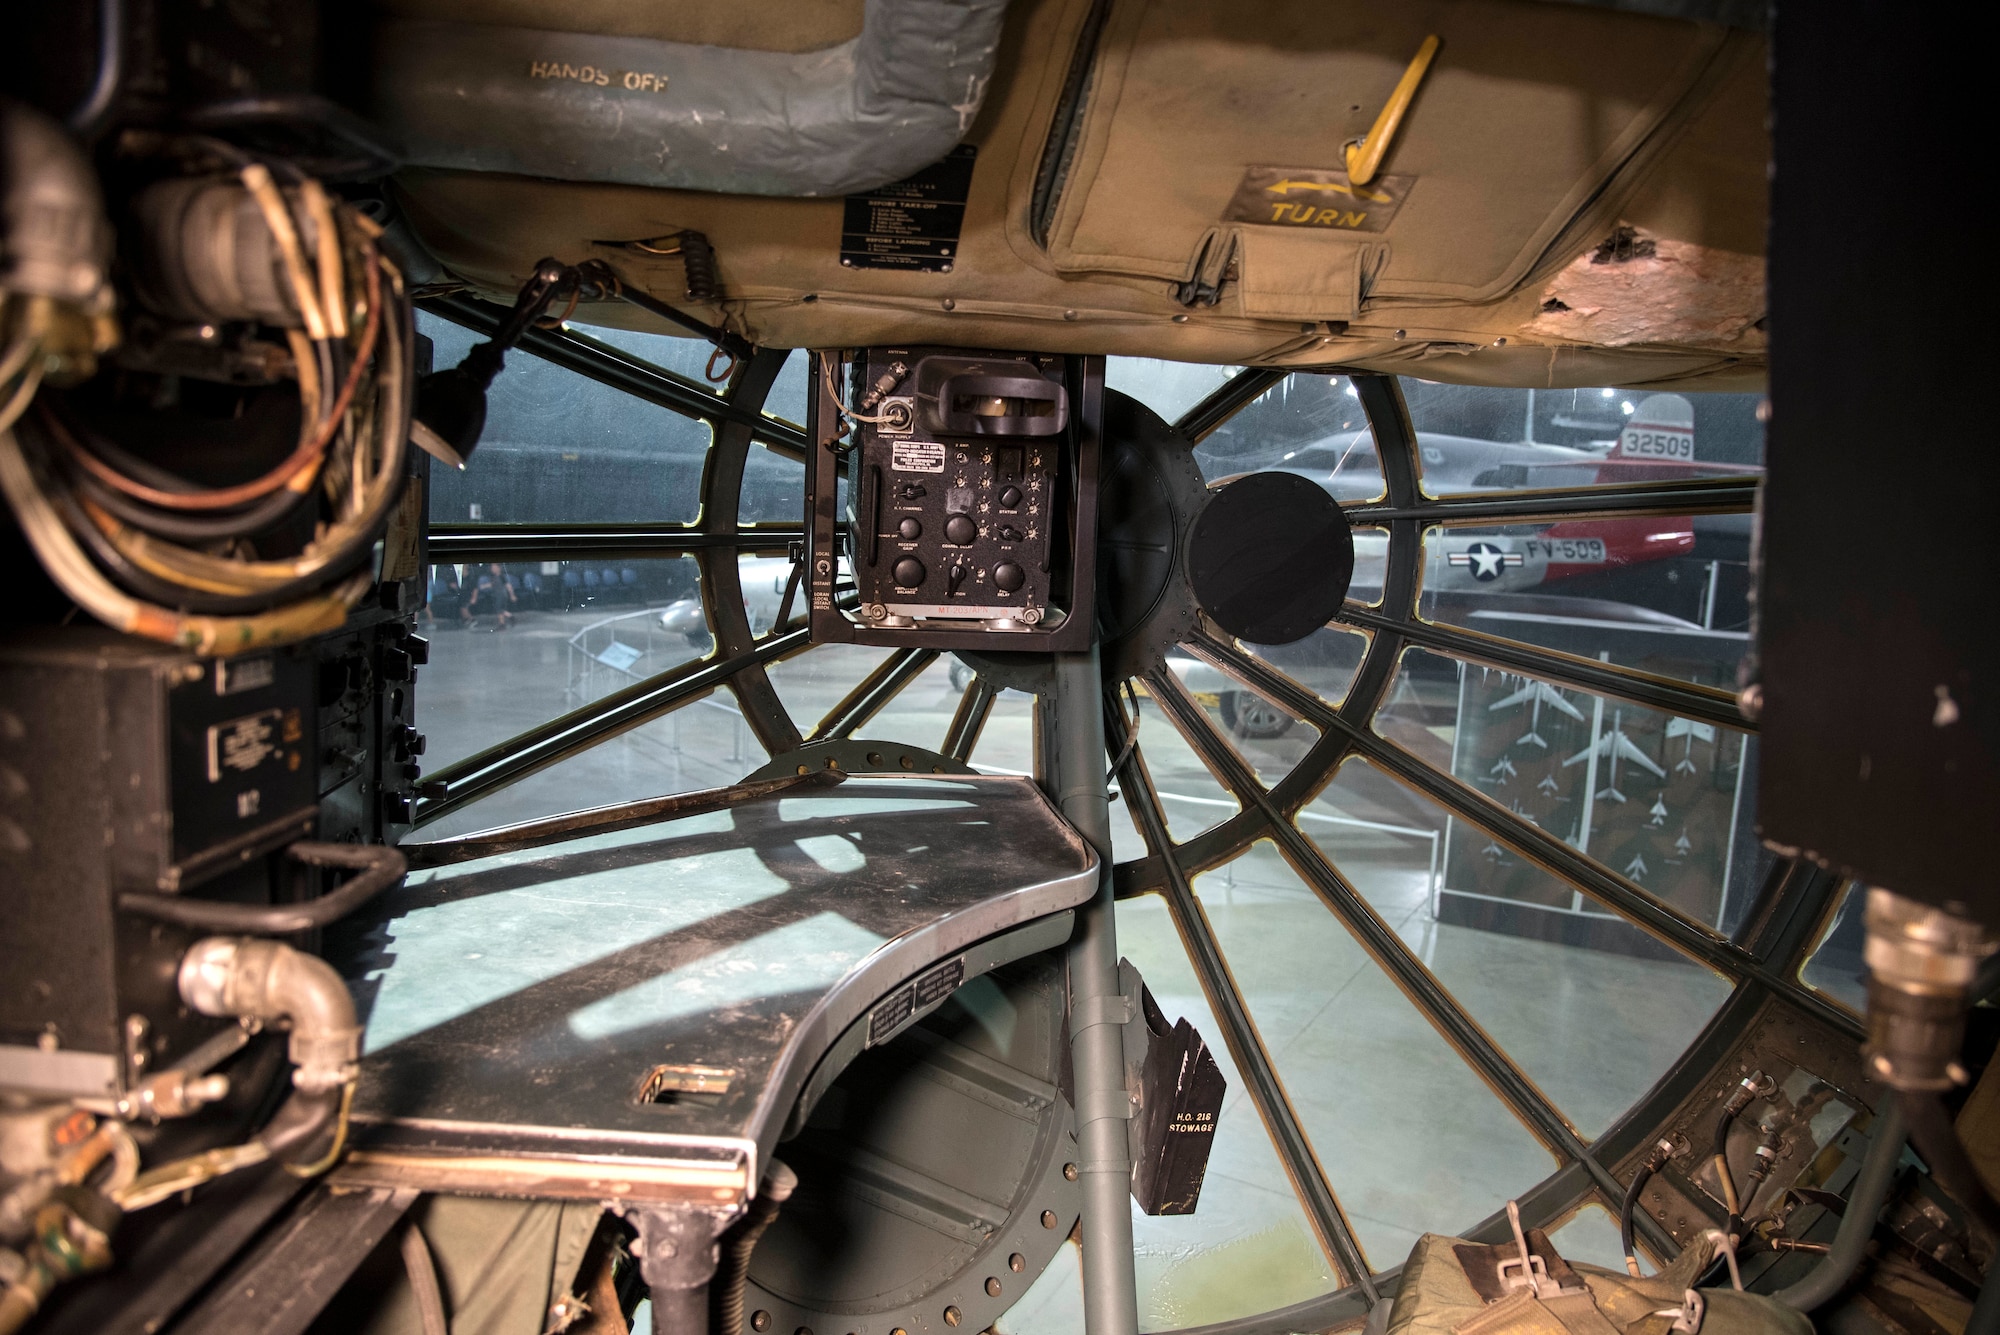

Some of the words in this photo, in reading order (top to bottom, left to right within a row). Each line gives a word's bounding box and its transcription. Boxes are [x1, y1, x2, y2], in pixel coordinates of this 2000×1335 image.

[530, 61, 610, 86] HANDS
[623, 71, 669, 93] OFF
[1270, 203, 1367, 228] TURN
[1626, 432, 1692, 457] 32509
[1526, 540, 1602, 560] FV-509
[1168, 1124, 1214, 1133] STOWAGE
